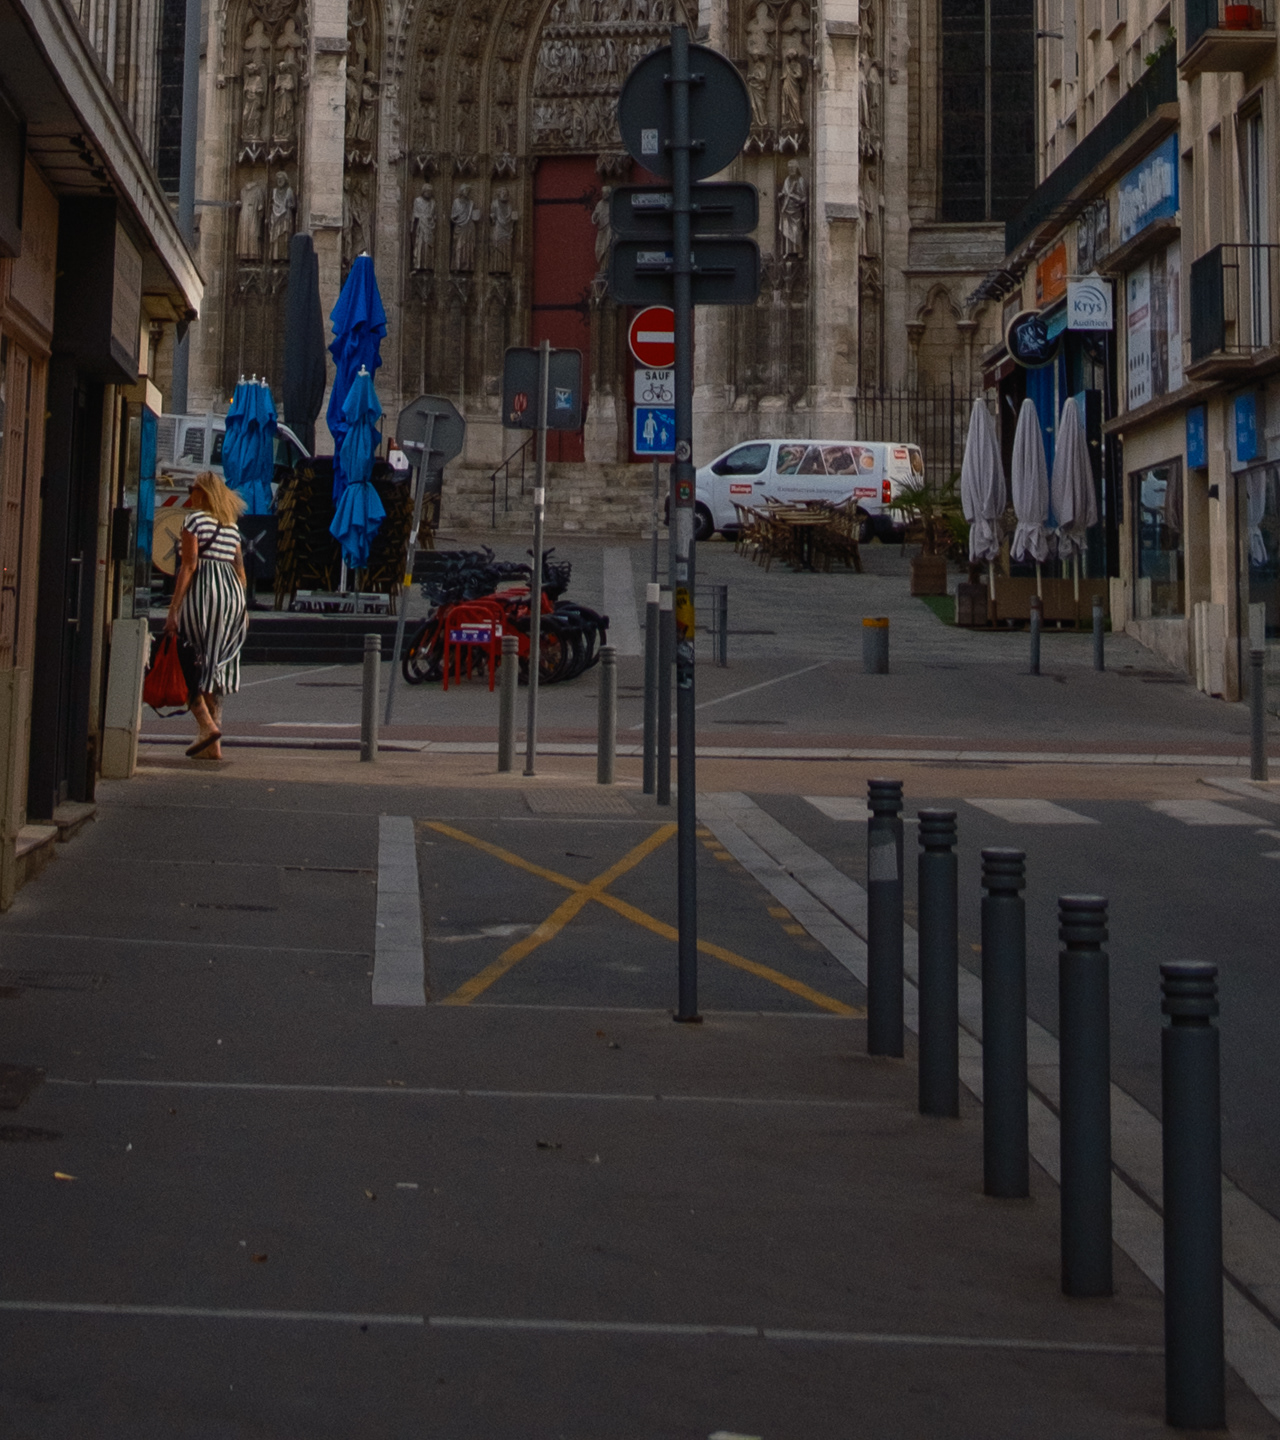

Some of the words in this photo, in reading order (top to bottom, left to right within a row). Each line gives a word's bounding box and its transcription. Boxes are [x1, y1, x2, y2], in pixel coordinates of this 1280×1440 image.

[1074, 300, 1102, 315] Krys
[1073, 319, 1108, 327] Audition
[645, 371, 670, 381] SAUF
